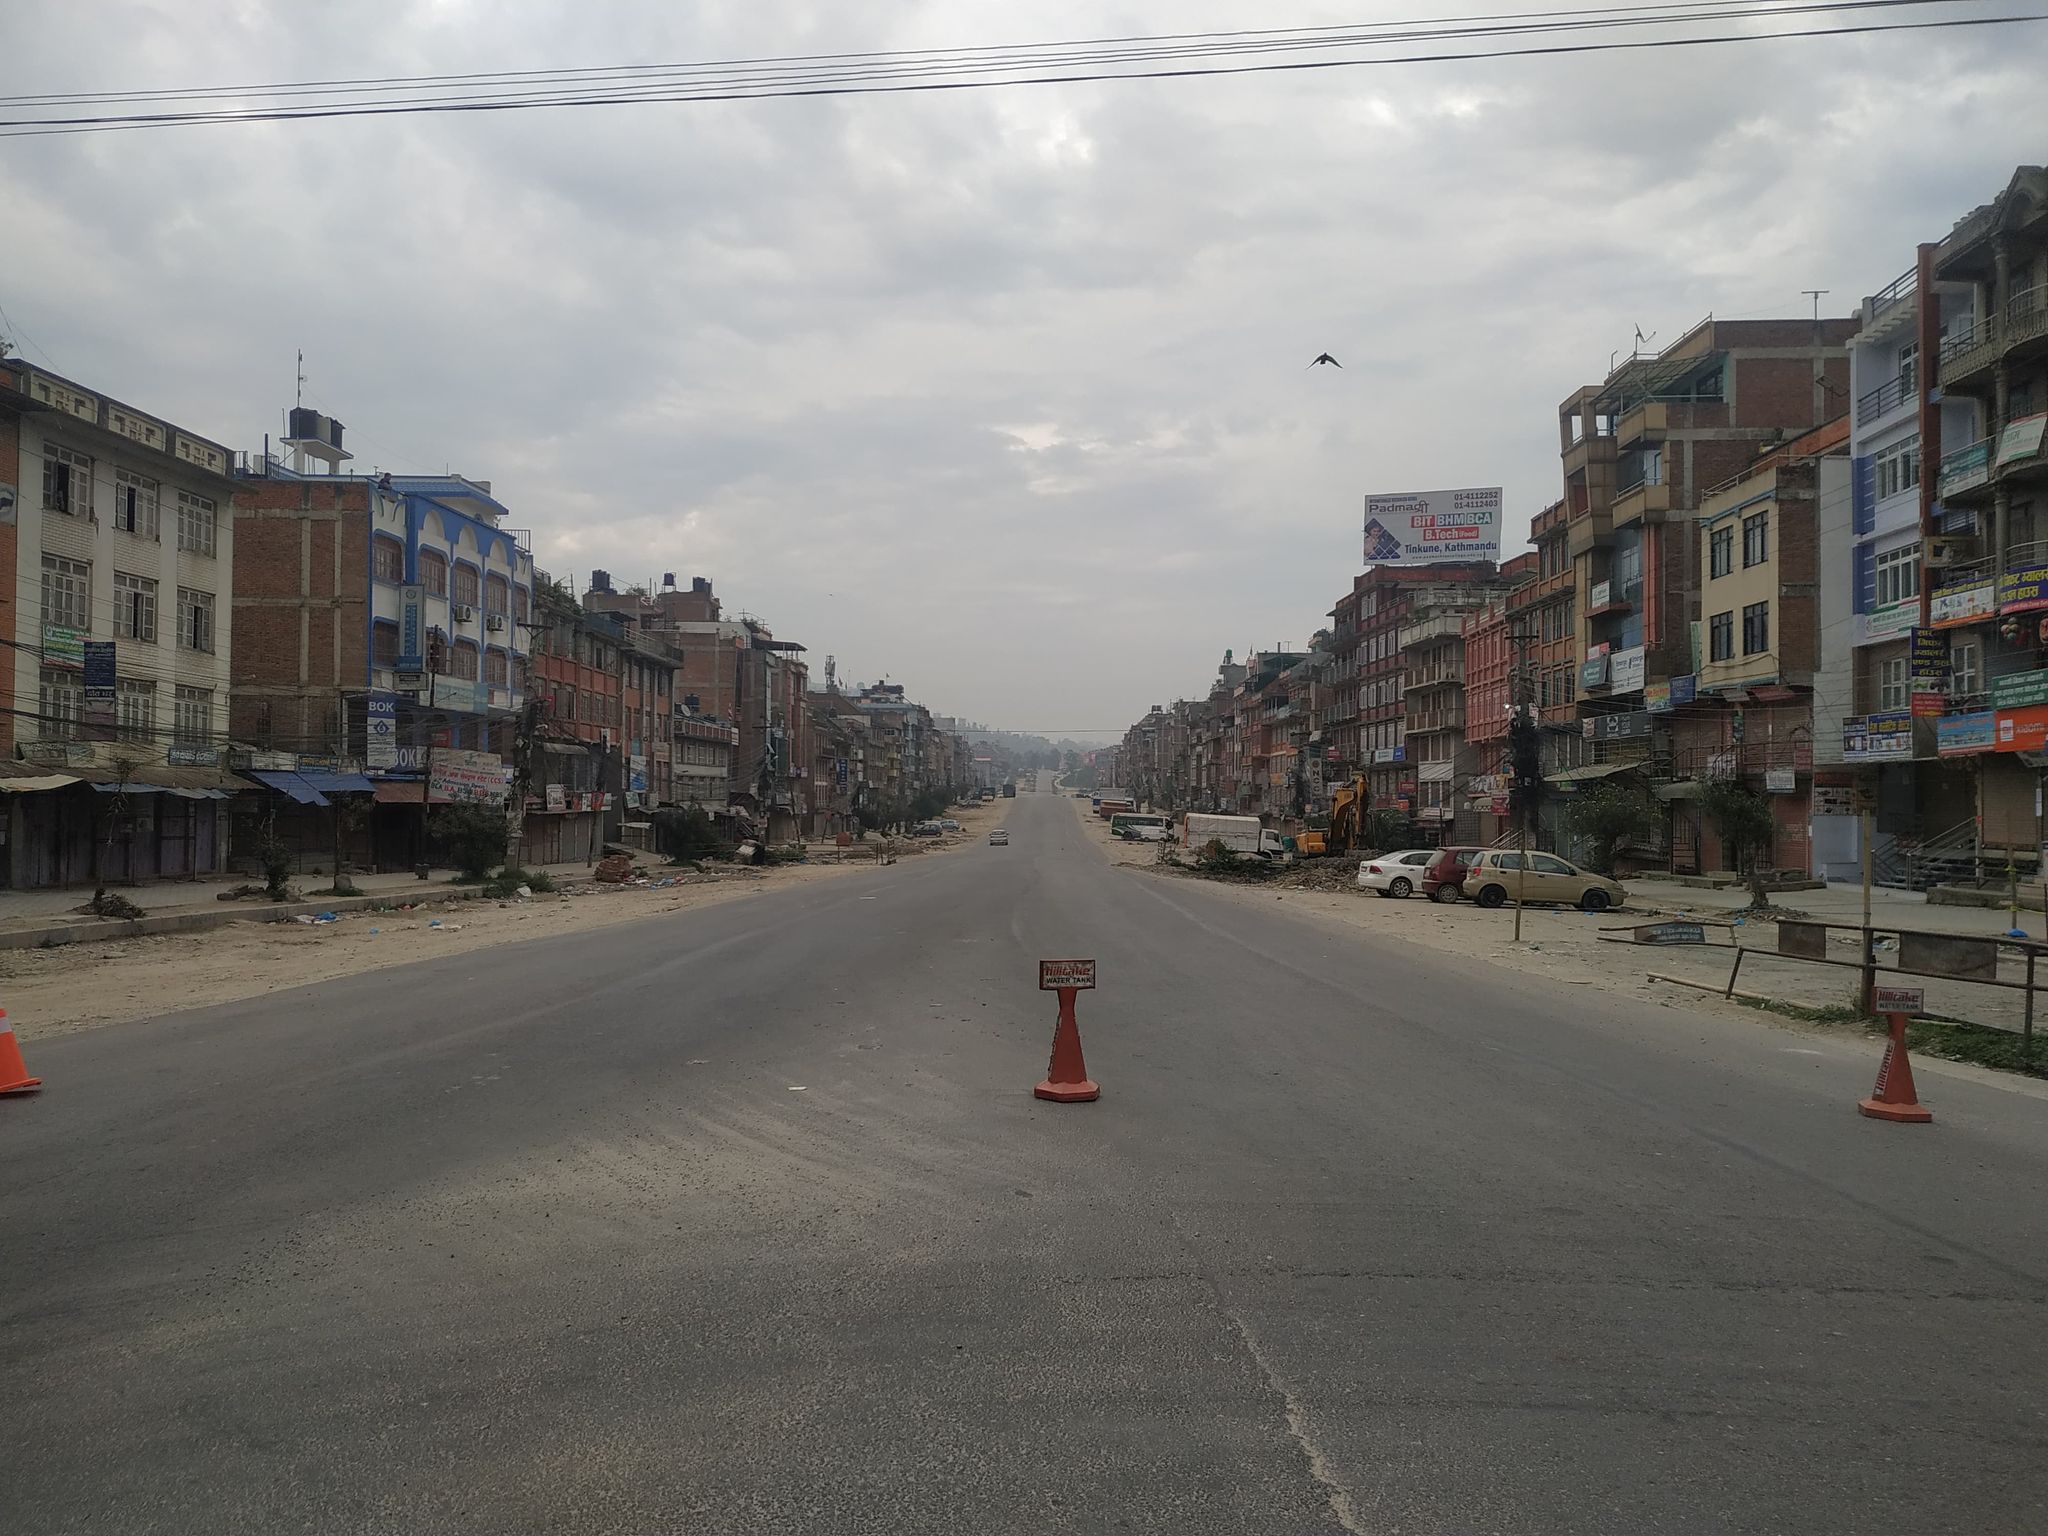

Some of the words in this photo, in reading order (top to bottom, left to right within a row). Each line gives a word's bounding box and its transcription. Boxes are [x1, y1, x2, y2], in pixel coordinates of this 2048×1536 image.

[1454, 492, 1498, 500] 01-4112252
[1413, 515, 1433, 527] BIT
[1437, 514, 1464, 526] BHM
[1467, 512, 1491, 524] BCA
[1425, 528, 1459, 540] B.Tech
[1405, 544, 1442, 554] Tinkune,
[1444, 541, 1497, 552] Kathmandu
[368, 701, 395, 713] BOK
[1046, 976, 1071, 985] WATER
[1072, 976, 1091, 984] TANK
[1878, 991, 1920, 1003] Hilltake
